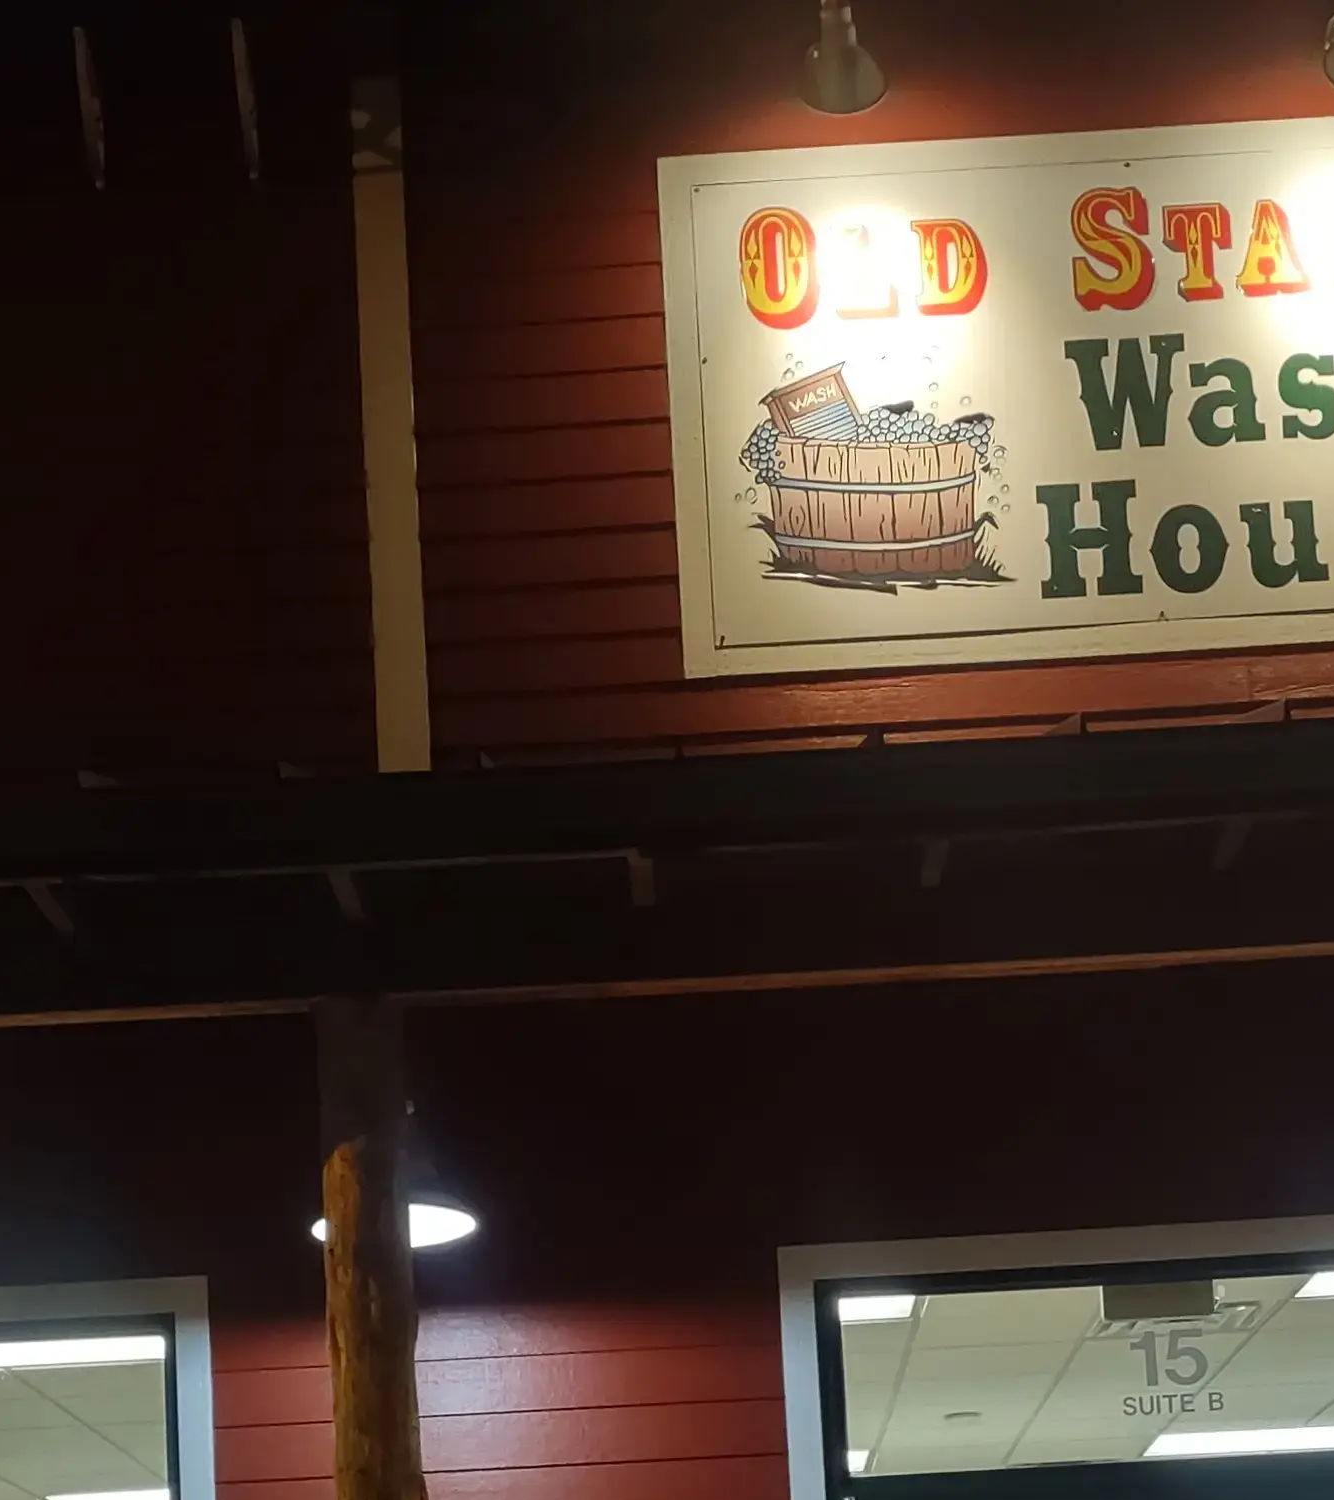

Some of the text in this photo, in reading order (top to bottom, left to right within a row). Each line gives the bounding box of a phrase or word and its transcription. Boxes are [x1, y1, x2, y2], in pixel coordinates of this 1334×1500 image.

[740, 206, 988, 330] OD
[788, 384, 837, 413] WASH
[1130, 1328, 1208, 1386] 15
[1123, 1392, 1224, 1416] SUITE B
